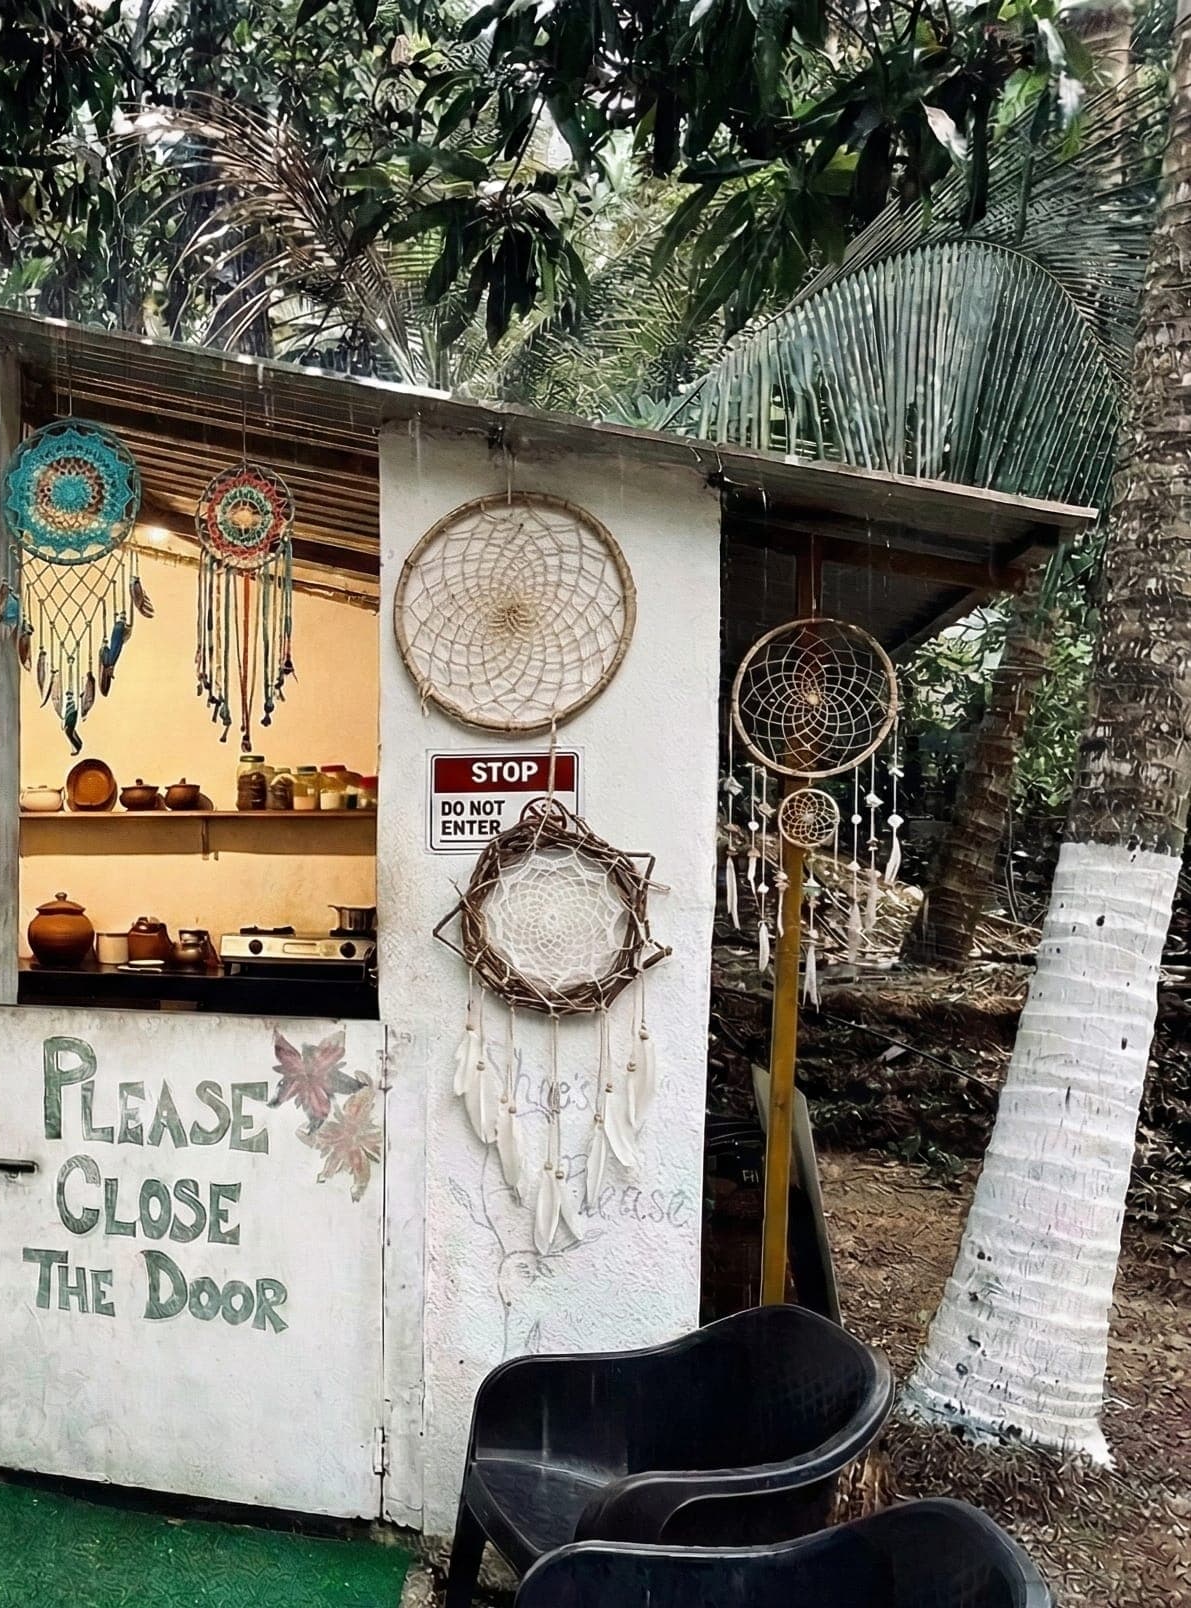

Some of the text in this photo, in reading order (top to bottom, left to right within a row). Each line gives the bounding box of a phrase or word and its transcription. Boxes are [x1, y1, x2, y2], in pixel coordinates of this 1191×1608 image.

[471, 760, 539, 784] STOP
[441, 800, 506, 816] DO NOT
[441, 820, 501, 836] ENTER
[42, 1035, 270, 1155] PLEASE
[55, 1154, 242, 1246] CLOSE
[21, 1247, 290, 1334] THE DOOR
